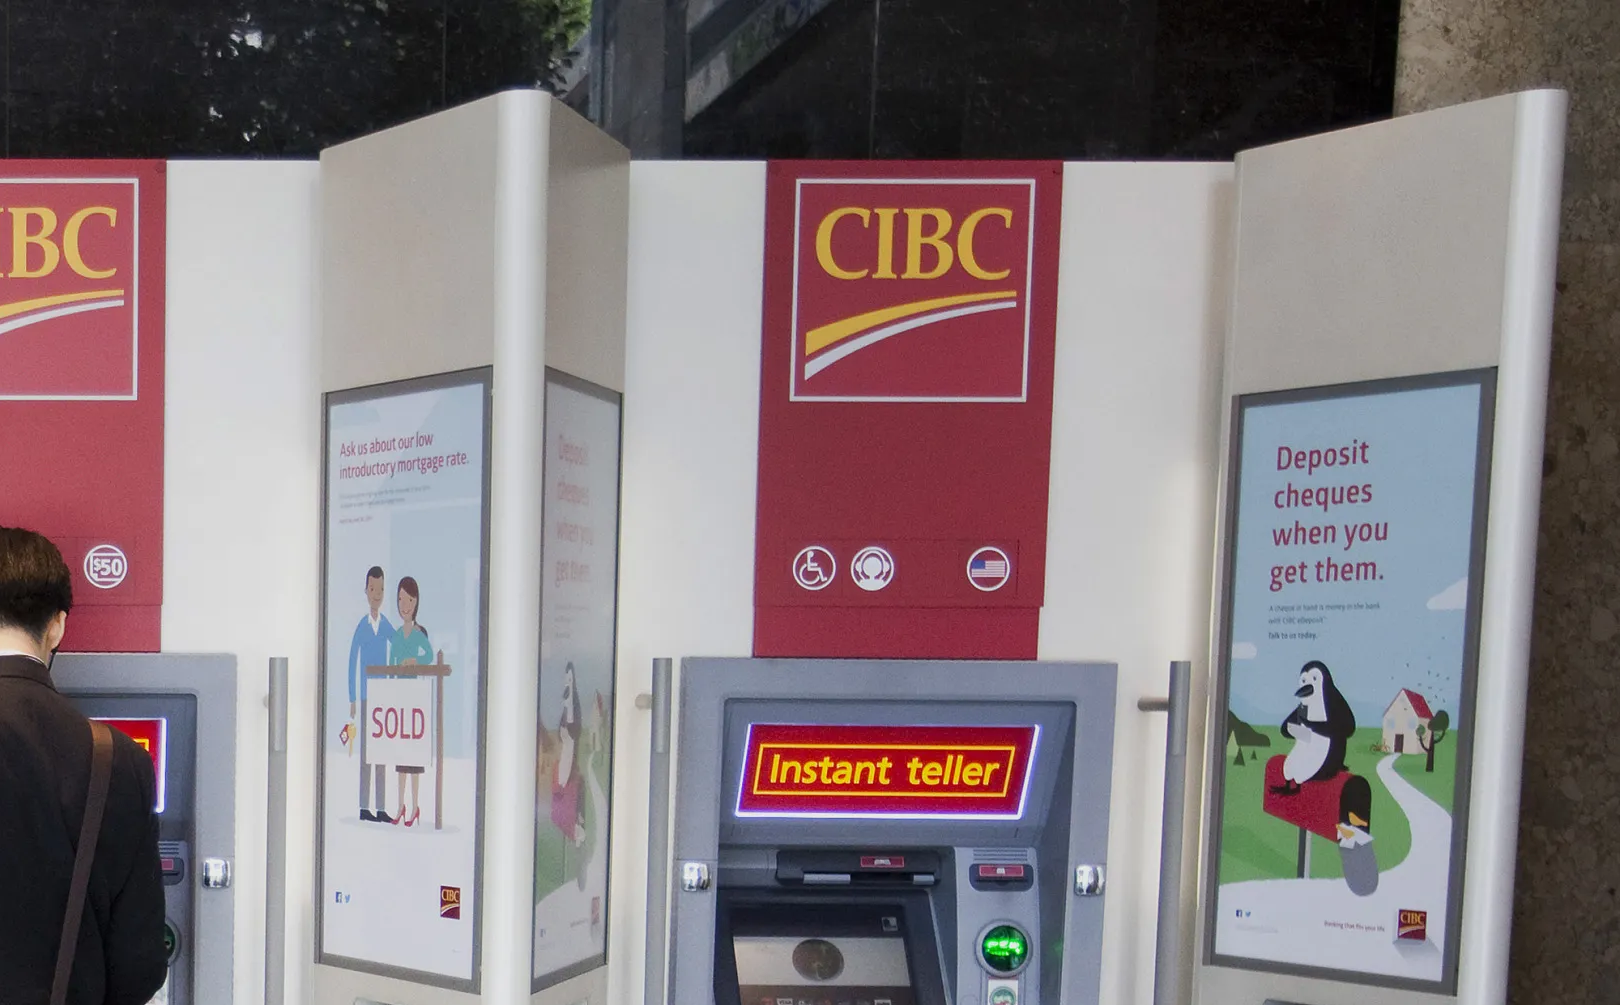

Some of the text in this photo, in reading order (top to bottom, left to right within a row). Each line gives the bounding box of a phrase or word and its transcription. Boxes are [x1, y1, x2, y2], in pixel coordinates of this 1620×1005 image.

[815, 207, 1013, 280] CIBC
[340, 431, 434, 458] Ask us about our low
[1277, 439, 1369, 475] Deposit
[340, 452, 469, 479] introductory mortgage rate.
[1274, 482, 1372, 512] cheques
[1272, 520, 1388, 551] when you
[93, 558, 123, 576] $50
[1270, 556, 1384, 592] get them.
[372, 707, 425, 739] SOLD
[770, 753, 1000, 785] Instant teller
[441, 889, 459, 902] CIBC
[1400, 911, 1425, 926] CIBC
